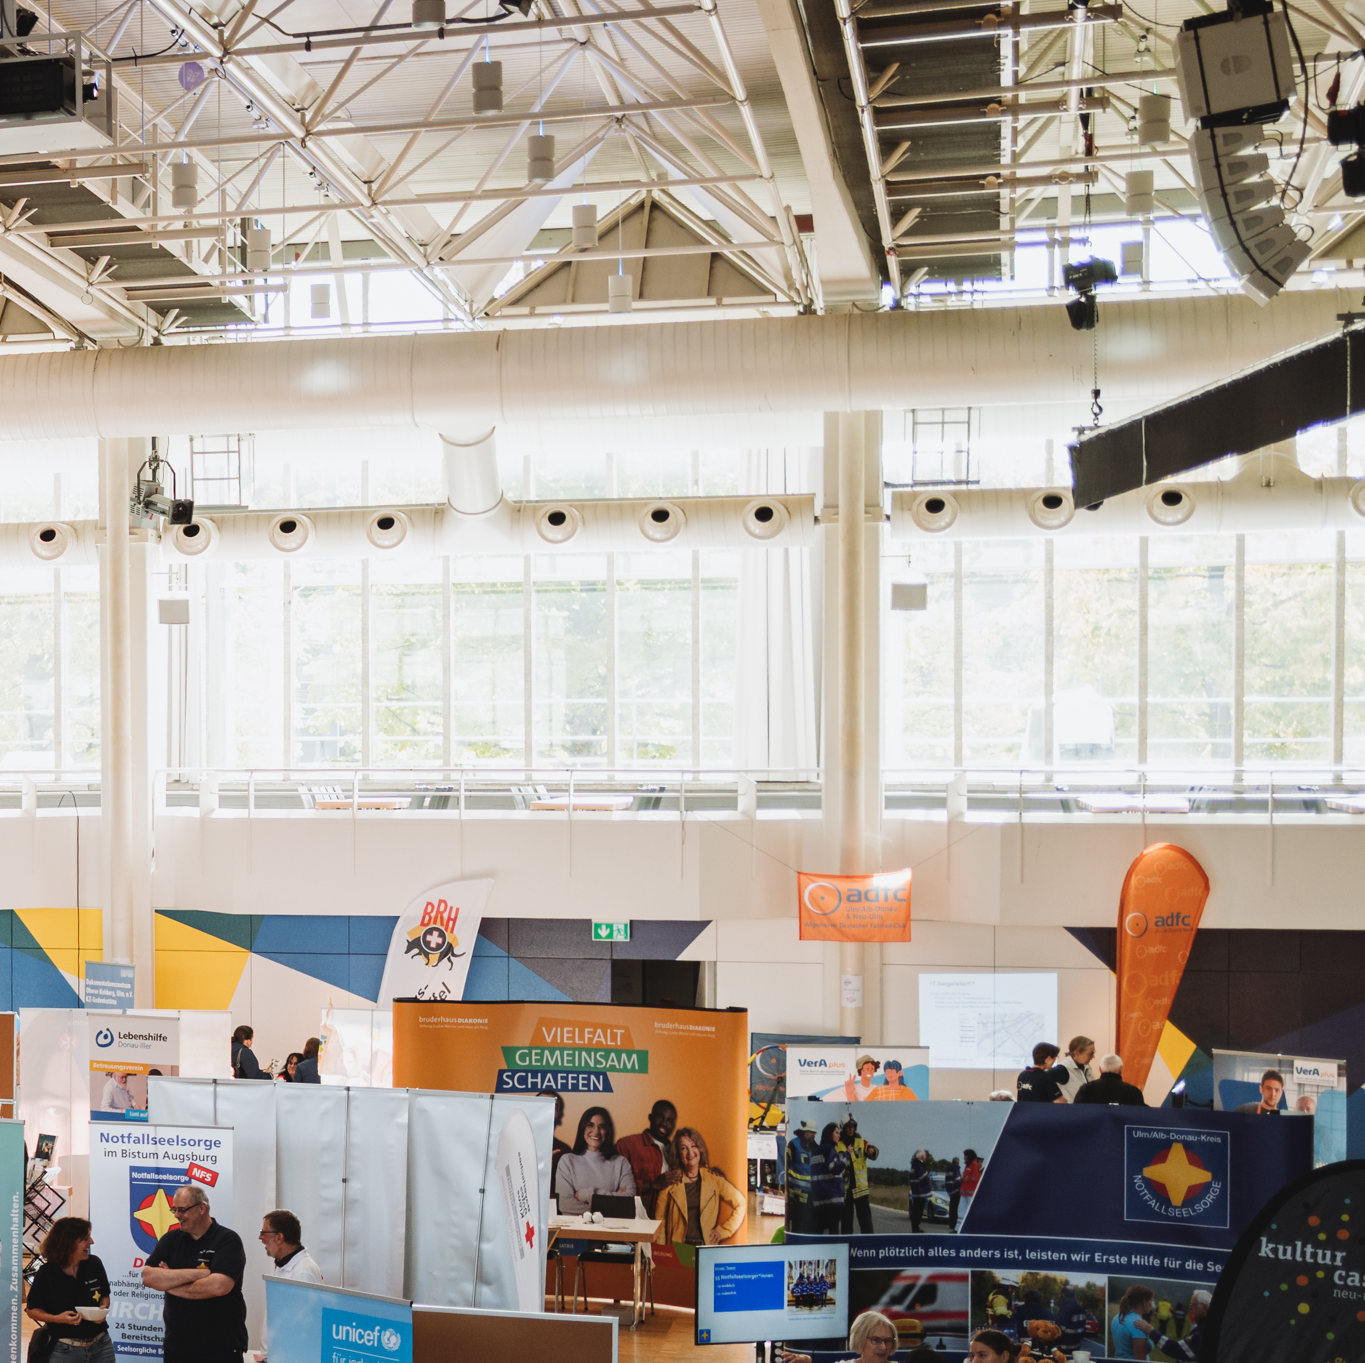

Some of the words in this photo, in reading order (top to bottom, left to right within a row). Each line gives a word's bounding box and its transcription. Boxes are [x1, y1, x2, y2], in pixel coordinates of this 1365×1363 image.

[846, 885, 907, 903] adfc
[421, 899, 459, 934] BRH
[1154, 913, 1191, 927] adfc
[419, 1016, 488, 1024] bruderhausDIAKONIE
[118, 1031, 167, 1043] Lebenshilfe
[542, 1026, 625, 1046] VIELFALT
[93, 1062, 144, 1072] Betreuungsverein
[515, 1049, 639, 1070] GEMEINSAM
[798, 1058, 827, 1068] VerA
[502, 1072, 604, 1091] SCHAFFEN
[100, 1132, 221, 1150] Notfallseelsorge
[1133, 1130, 1221, 1143] Ulm/Alb-Donau-Kreis
[104, 1148, 117, 1157] im
[121, 1149, 159, 1160] Bistum
[163, 1151, 218, 1164] Augsburg
[132, 1172, 189, 1182] Notfallseelsorge
[192, 1167, 213, 1182] NFS
[1133, 1174, 1221, 1218] NOTFALLSEELSORGE
[10, 1191, 20, 1292] Zusammenhalten.
[879, 1246, 925, 1258] plötzlich
[928, 1246, 956, 1257] alles
[960, 1247, 1000, 1259] anders
[1004, 1247, 1022, 1260] ist,
[1026, 1249, 1067, 1261] leisten
[1071, 1251, 1091, 1262] wir
[1094, 1252, 1127, 1264] Erste
[1131, 1254, 1160, 1267] Hilfe
[1164, 1256, 1181, 1268] für
[1185, 1259, 1203, 1271] die
[1259, 1237, 1346, 1266] kultur
[128, 1324, 163, 1332] Stunden
[332, 1323, 380, 1347] unicef
